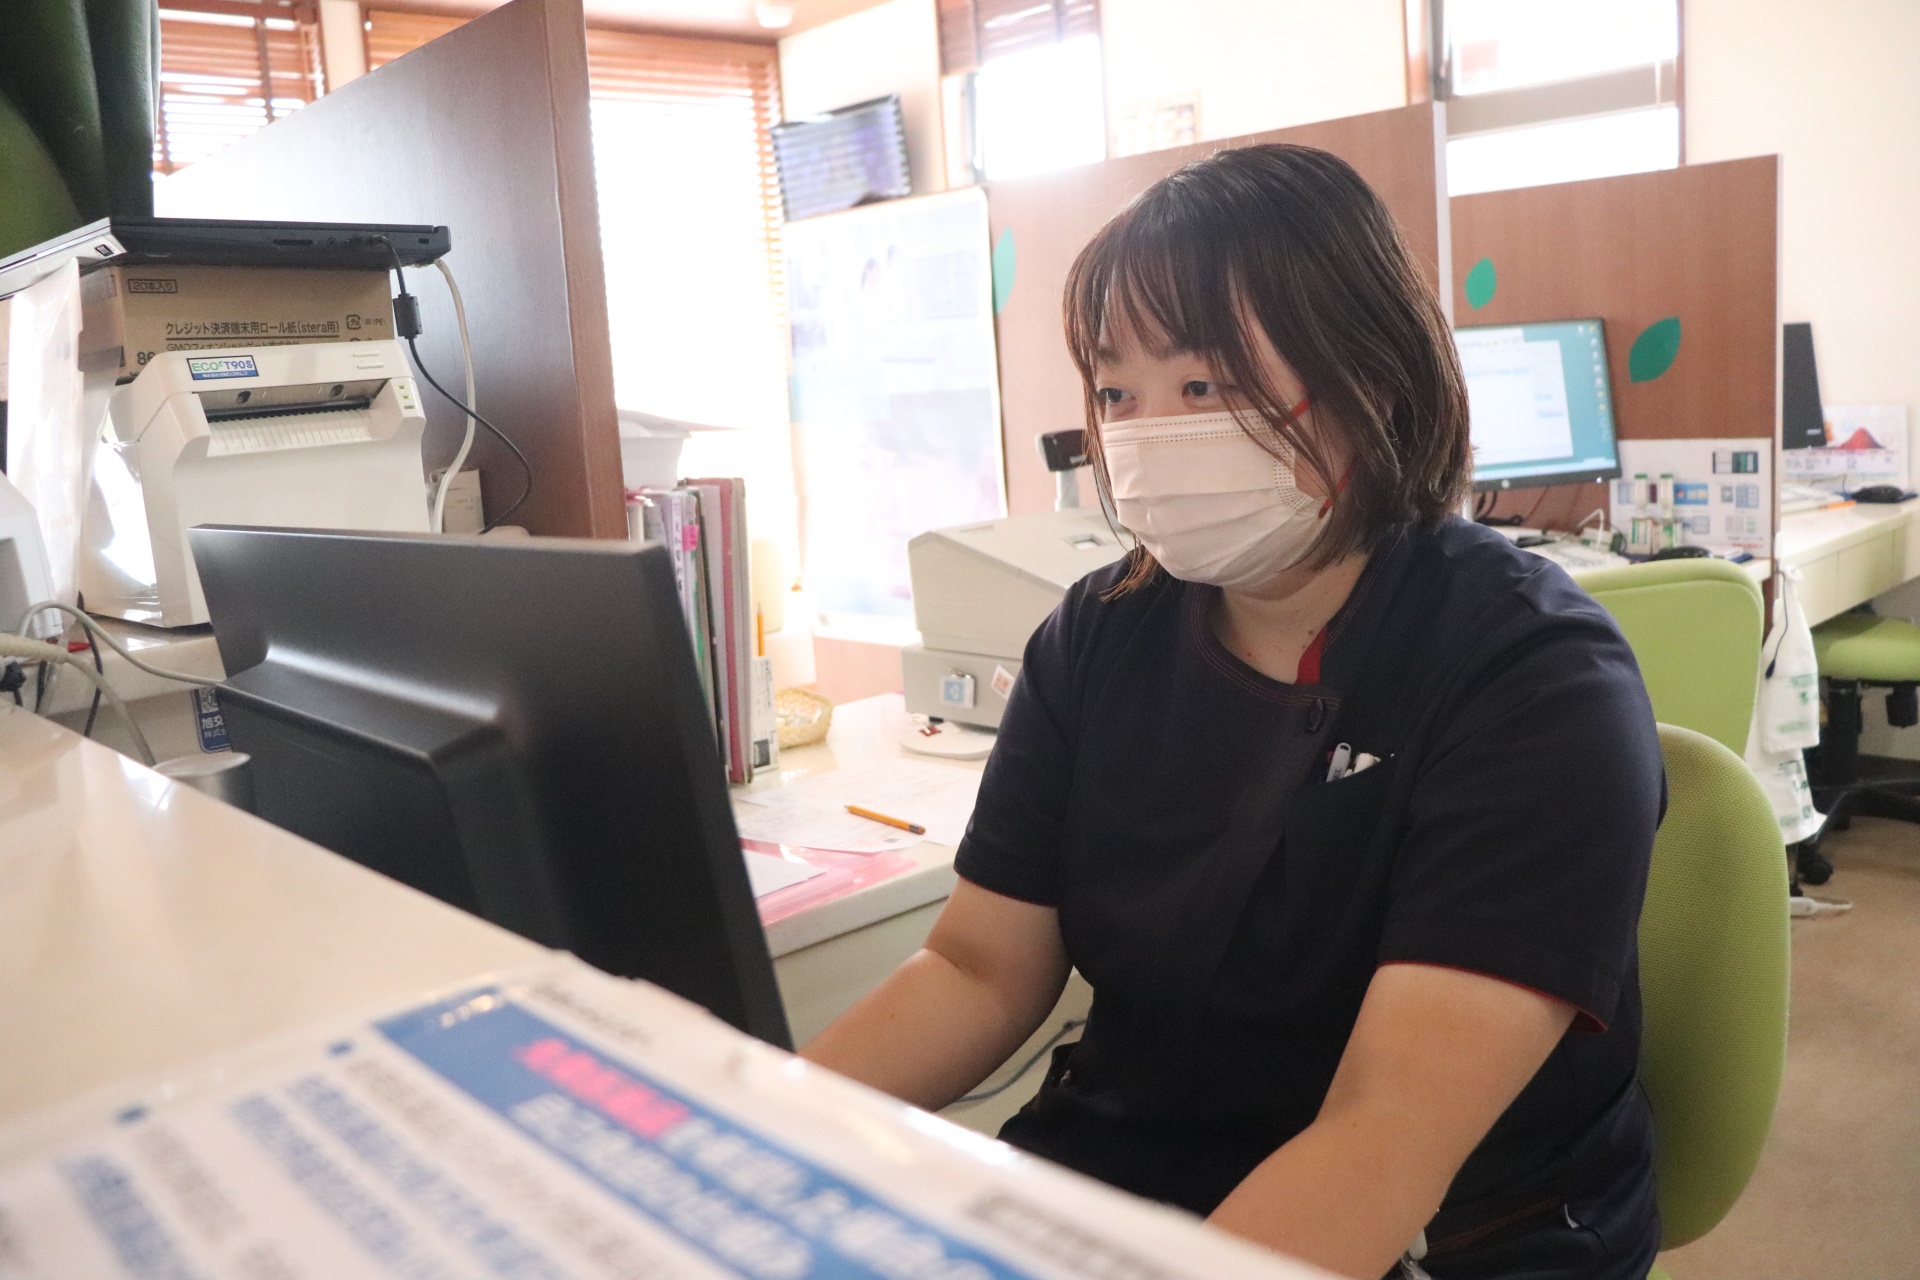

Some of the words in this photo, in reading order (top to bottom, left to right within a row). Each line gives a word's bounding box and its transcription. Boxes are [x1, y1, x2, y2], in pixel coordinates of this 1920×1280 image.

[165, 321, 340, 336] クレジット決済端末用ロール紙(stera用)
[223, 360, 253, 370] T90S
